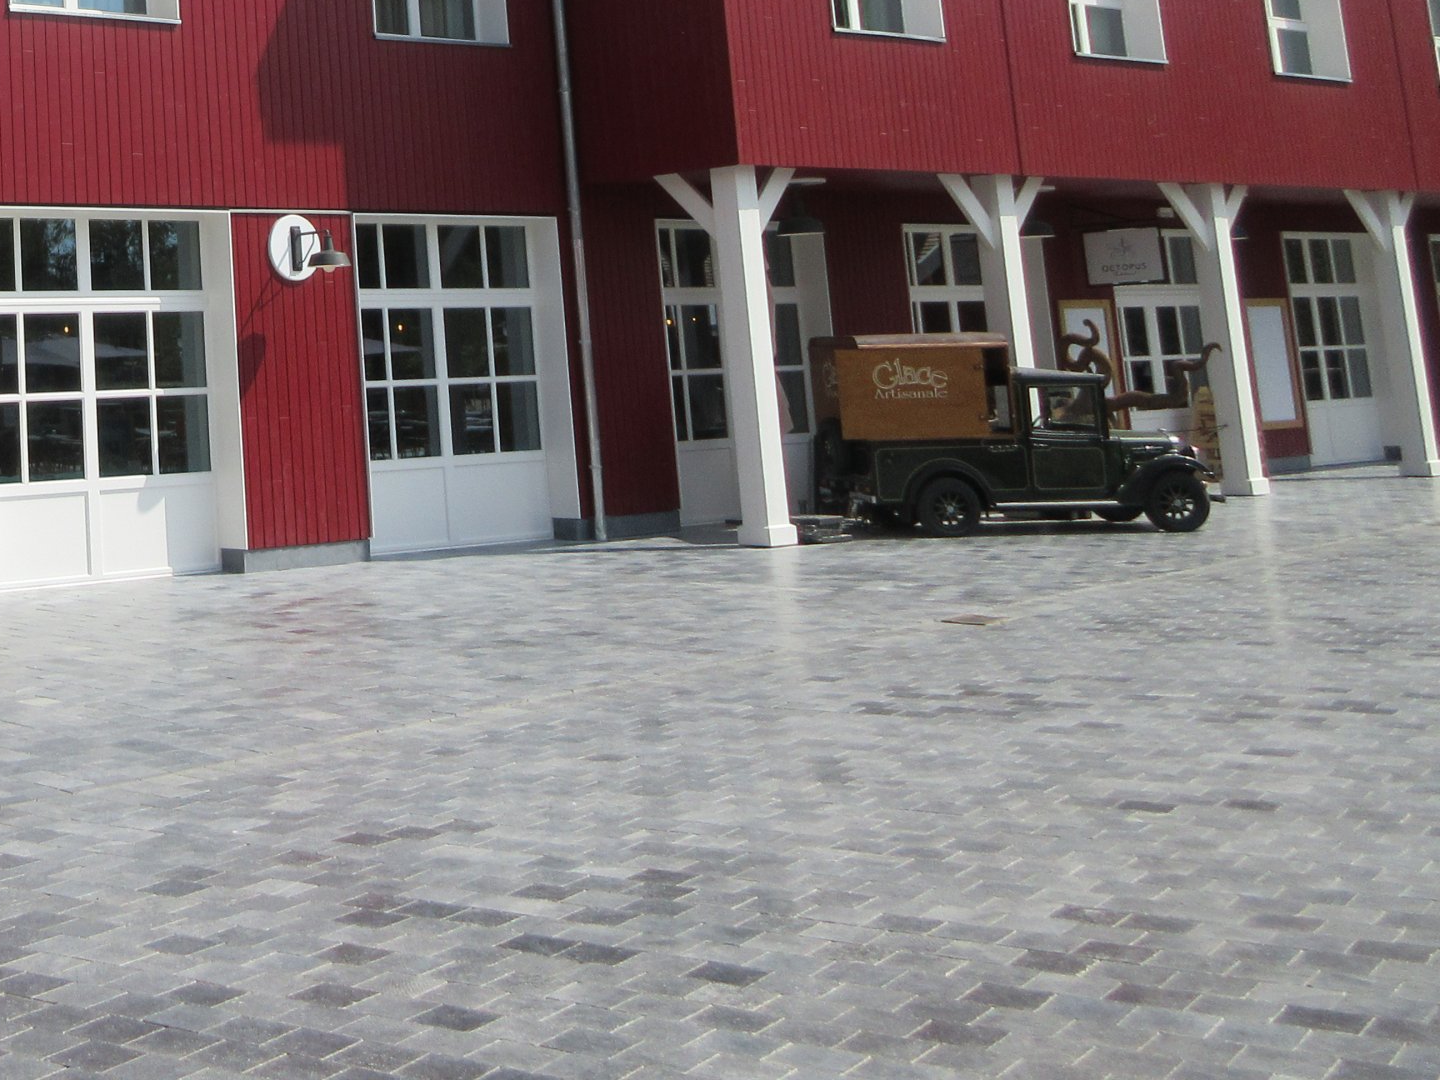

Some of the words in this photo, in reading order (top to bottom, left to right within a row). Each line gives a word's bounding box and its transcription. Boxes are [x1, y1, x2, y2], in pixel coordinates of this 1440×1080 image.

[1101, 262, 1147, 273] OCTOPUS
[872, 358, 948, 389] Glace
[874, 388, 948, 400] Artisanale
